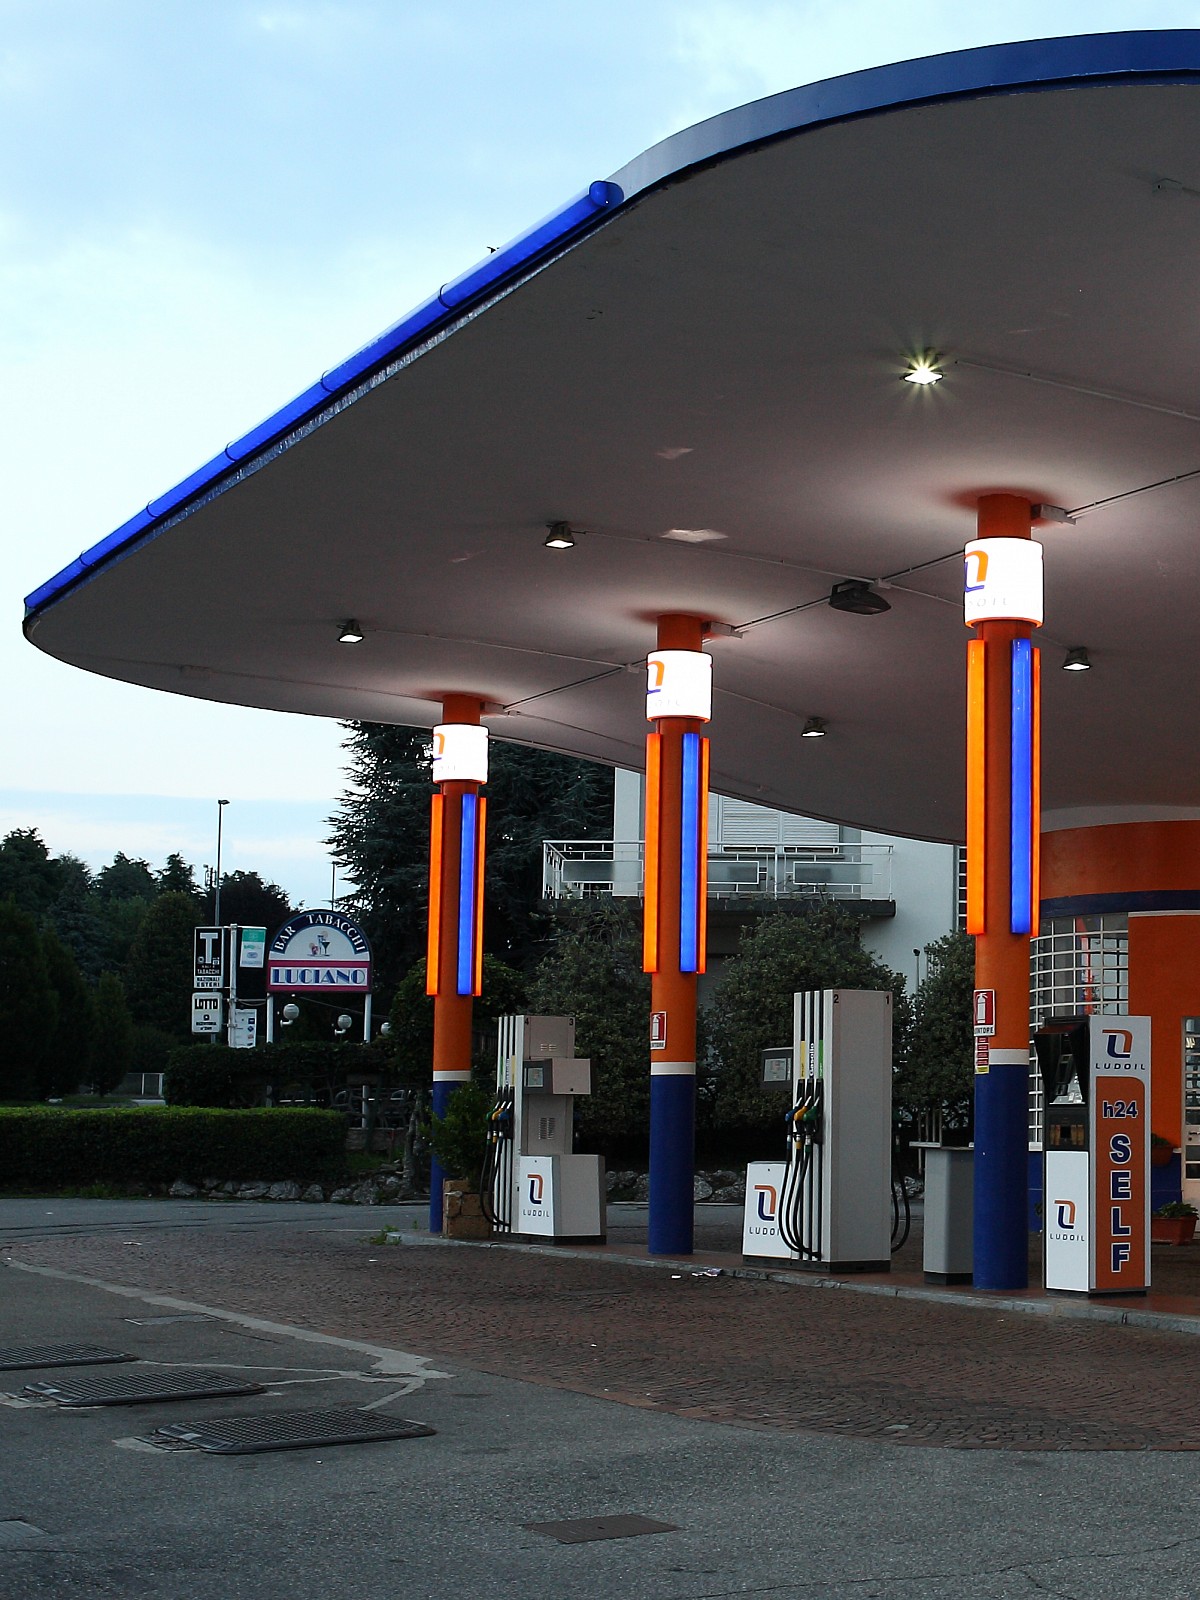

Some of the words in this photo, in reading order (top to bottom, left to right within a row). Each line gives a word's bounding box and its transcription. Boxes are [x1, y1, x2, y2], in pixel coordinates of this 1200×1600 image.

[274, 925, 296, 950] BAR
[306, 914, 366, 951] TABACCHI
[272, 968, 366, 984] LUCIANO
[833, 994, 839, 1003] 2
[886, 995, 890, 1005] 1
[194, 998, 219, 1010] LOTTO
[569, 1018, 574, 1026] 3
[1095, 1062, 1146, 1071] LUDOIL
[1103, 1101, 1138, 1118] h24
[1109, 1133, 1132, 1273] SELF
[522, 1209, 550, 1218] LUDOIL
[749, 1226, 780, 1236] LUDOI
[1049, 1233, 1085, 1242] LUDOIL
